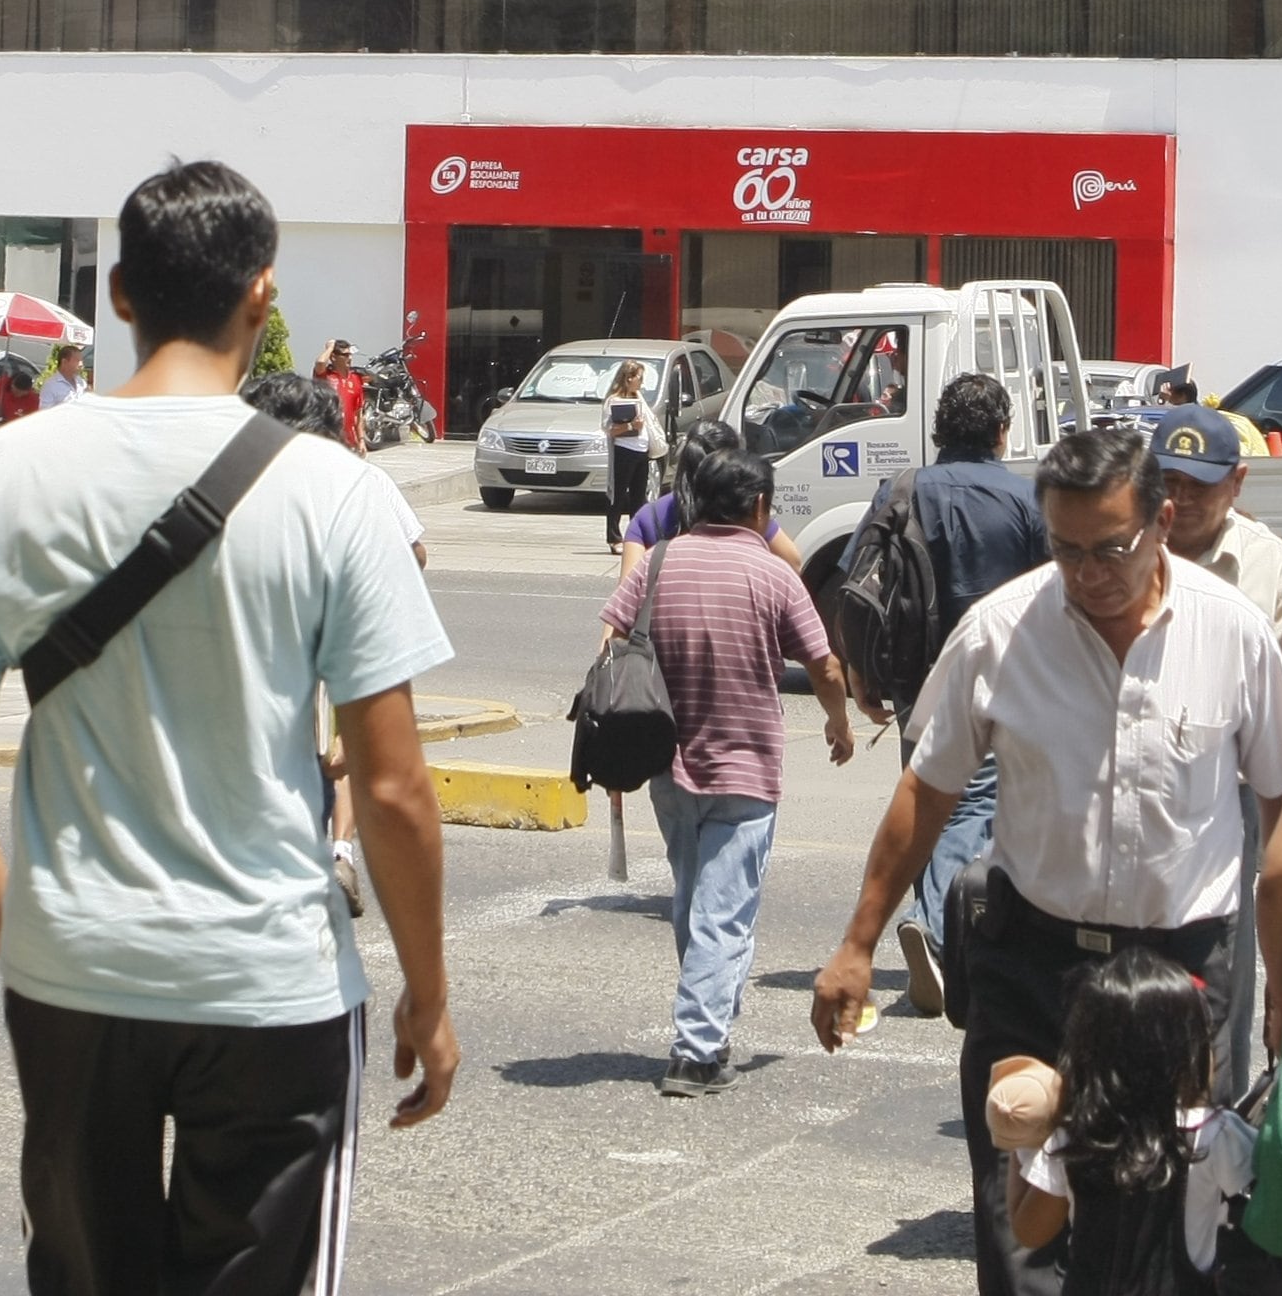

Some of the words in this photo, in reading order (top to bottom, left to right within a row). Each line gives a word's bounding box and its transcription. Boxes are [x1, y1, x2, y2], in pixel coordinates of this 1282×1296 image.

[736, 147, 809, 166] carsa
[470, 170, 520, 180] SOCIALMENTE
[470, 181, 519, 189] RESPONSABLE
[732, 166, 796, 211] 60
[1072, 170, 1137, 210] Perú
[786, 198, 811, 209] años
[741, 212, 754, 221] en
[756, 210, 767, 221] tu
[769, 209, 811, 222] corazón
[797, 483, 810, 492] 167
[783, 494, 809, 502] Callao
[791, 505, 812, 515] 1926
